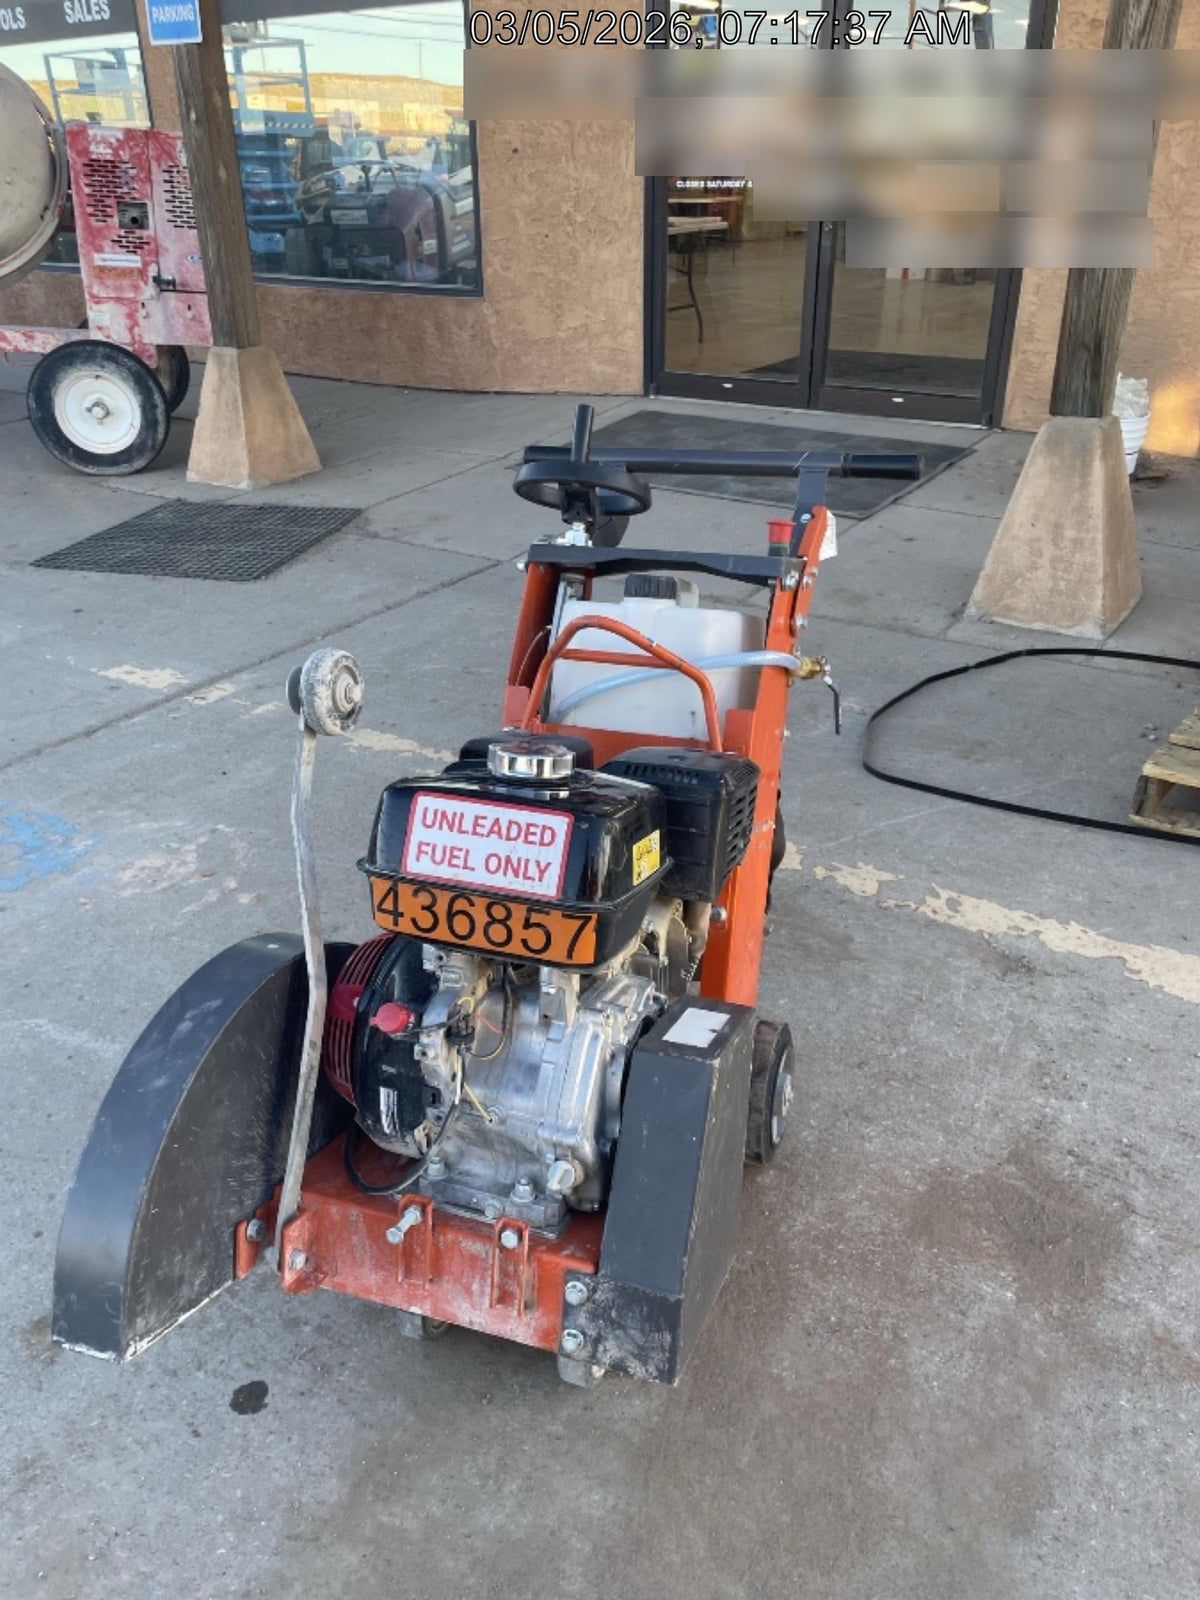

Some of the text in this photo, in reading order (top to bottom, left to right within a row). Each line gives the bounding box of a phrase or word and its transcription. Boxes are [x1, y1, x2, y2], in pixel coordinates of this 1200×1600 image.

[63, 0, 110, 23] SALES
[151, 3, 195, 24] PARKING
[421, 806, 557, 847] UNLEADED
[415, 840, 553, 882] FUEL ONLY
[376, 880, 593, 960] 436857
